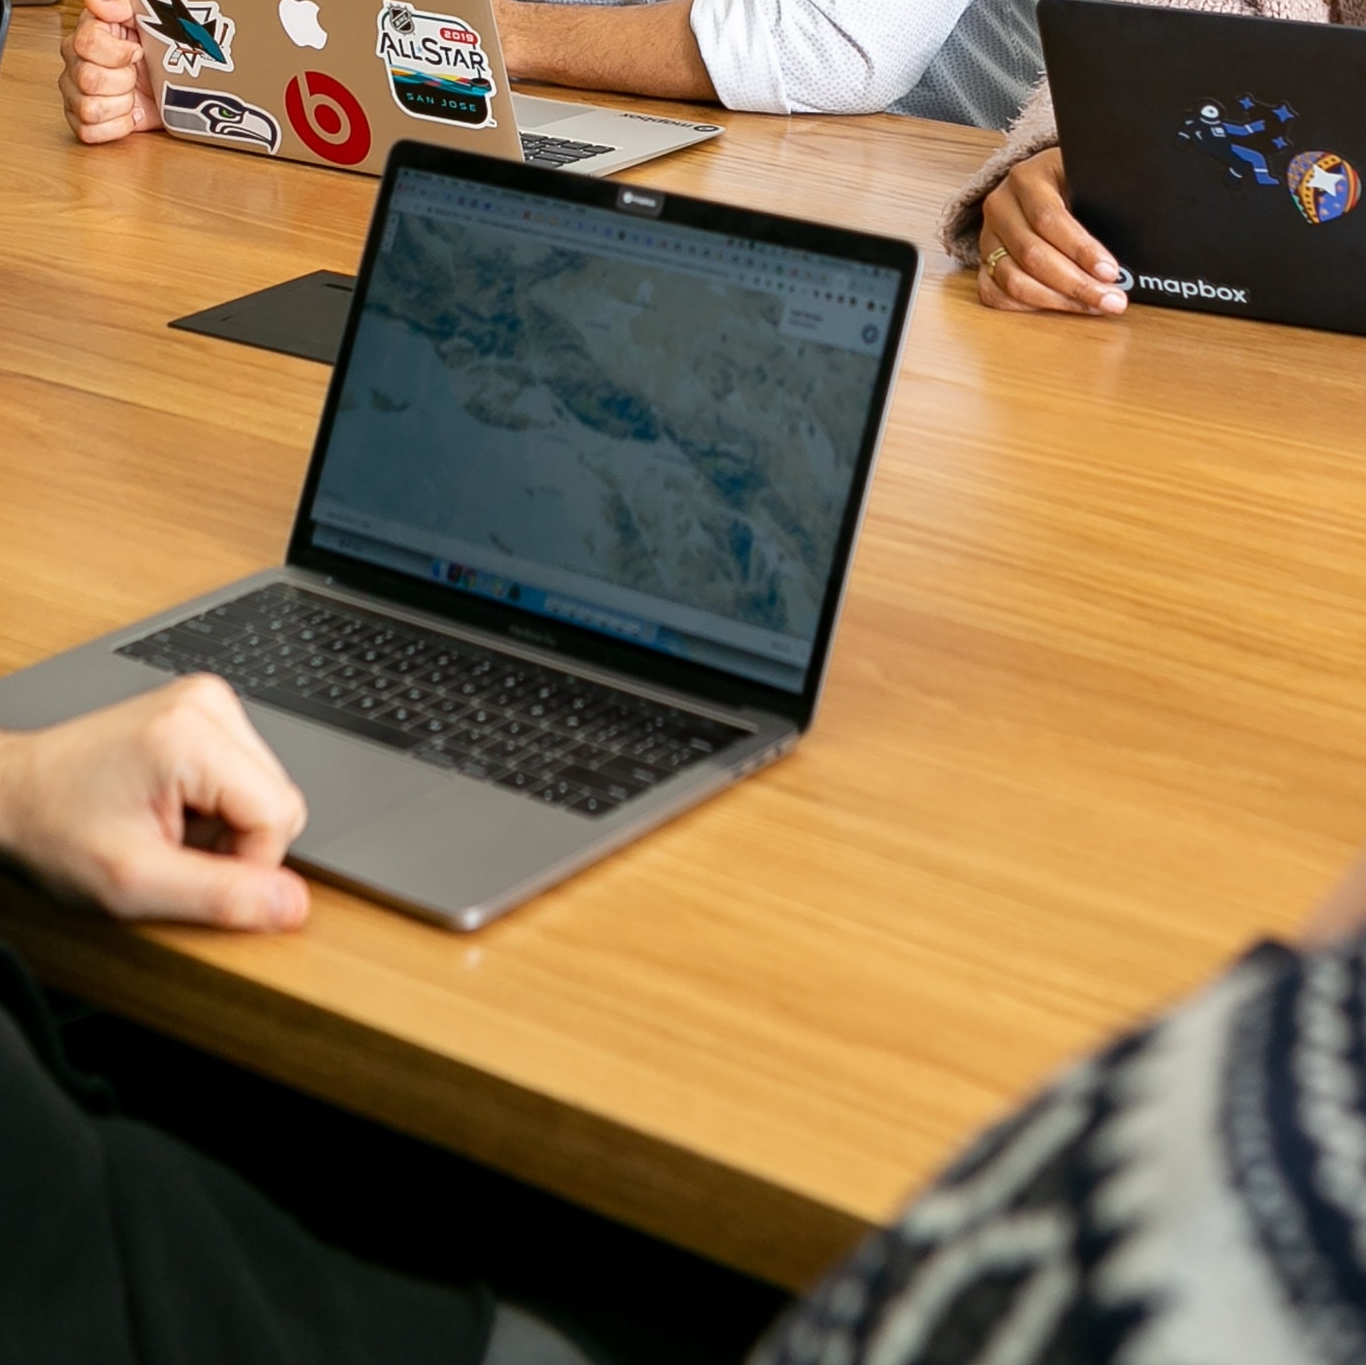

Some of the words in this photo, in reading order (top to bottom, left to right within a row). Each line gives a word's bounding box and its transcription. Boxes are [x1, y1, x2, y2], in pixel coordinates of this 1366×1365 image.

[443, 30, 475, 44] 2019
[405, 92, 435, 105] SAN
[440, 98, 477, 113] JOSE
[619, 113, 693, 128] mapbox
[1138, 274, 1248, 304] mapbox
